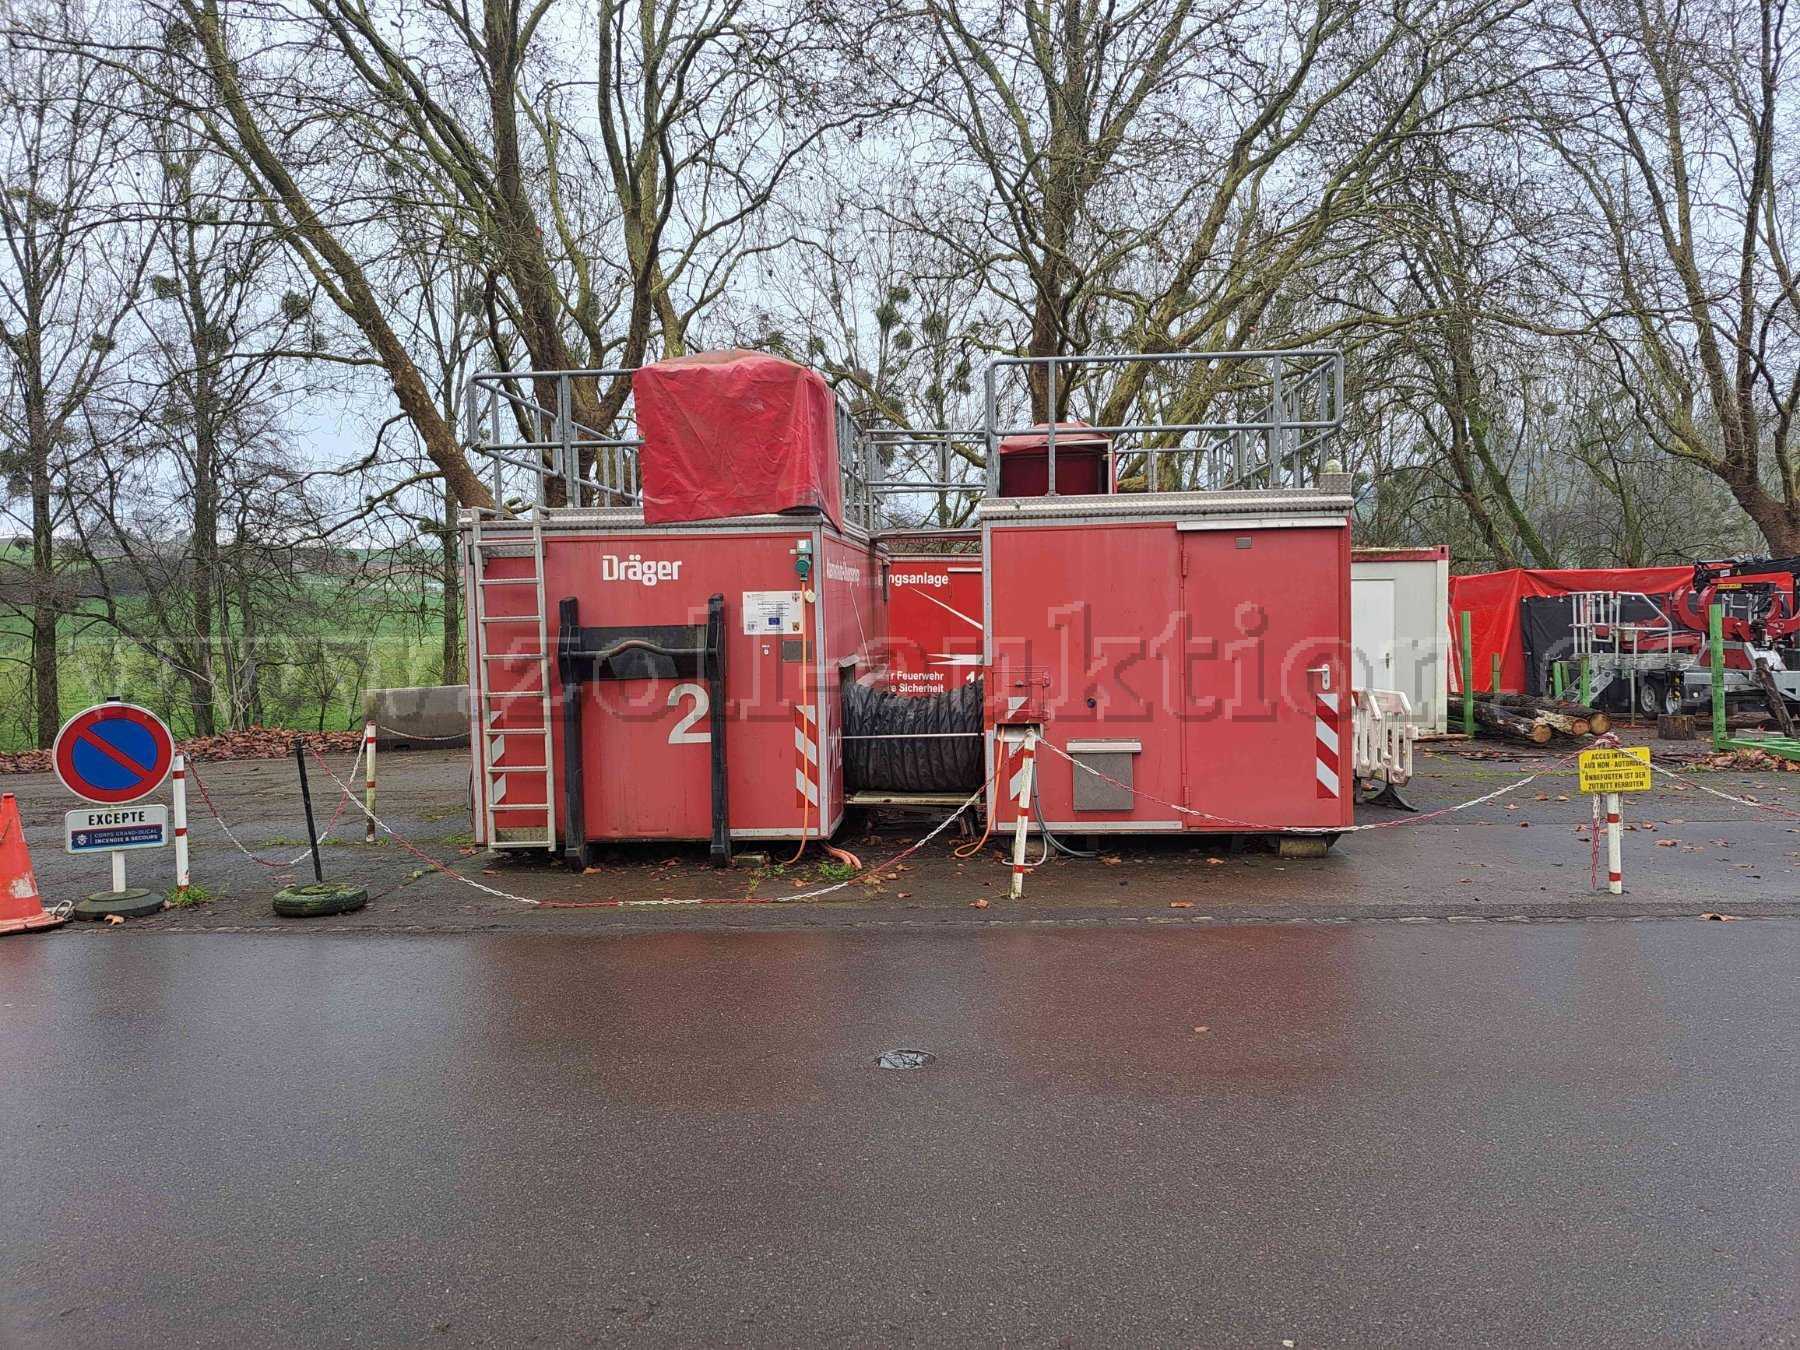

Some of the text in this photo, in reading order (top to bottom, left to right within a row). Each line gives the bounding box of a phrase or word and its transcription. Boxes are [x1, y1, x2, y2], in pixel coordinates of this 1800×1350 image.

[602, 554, 682, 586] Dräger
[897, 671, 944, 681] Feuerwehr
[898, 683, 944, 693] Sicherheit
[667, 683, 712, 744] 2
[88, 811, 146, 826] EXCEPTE
